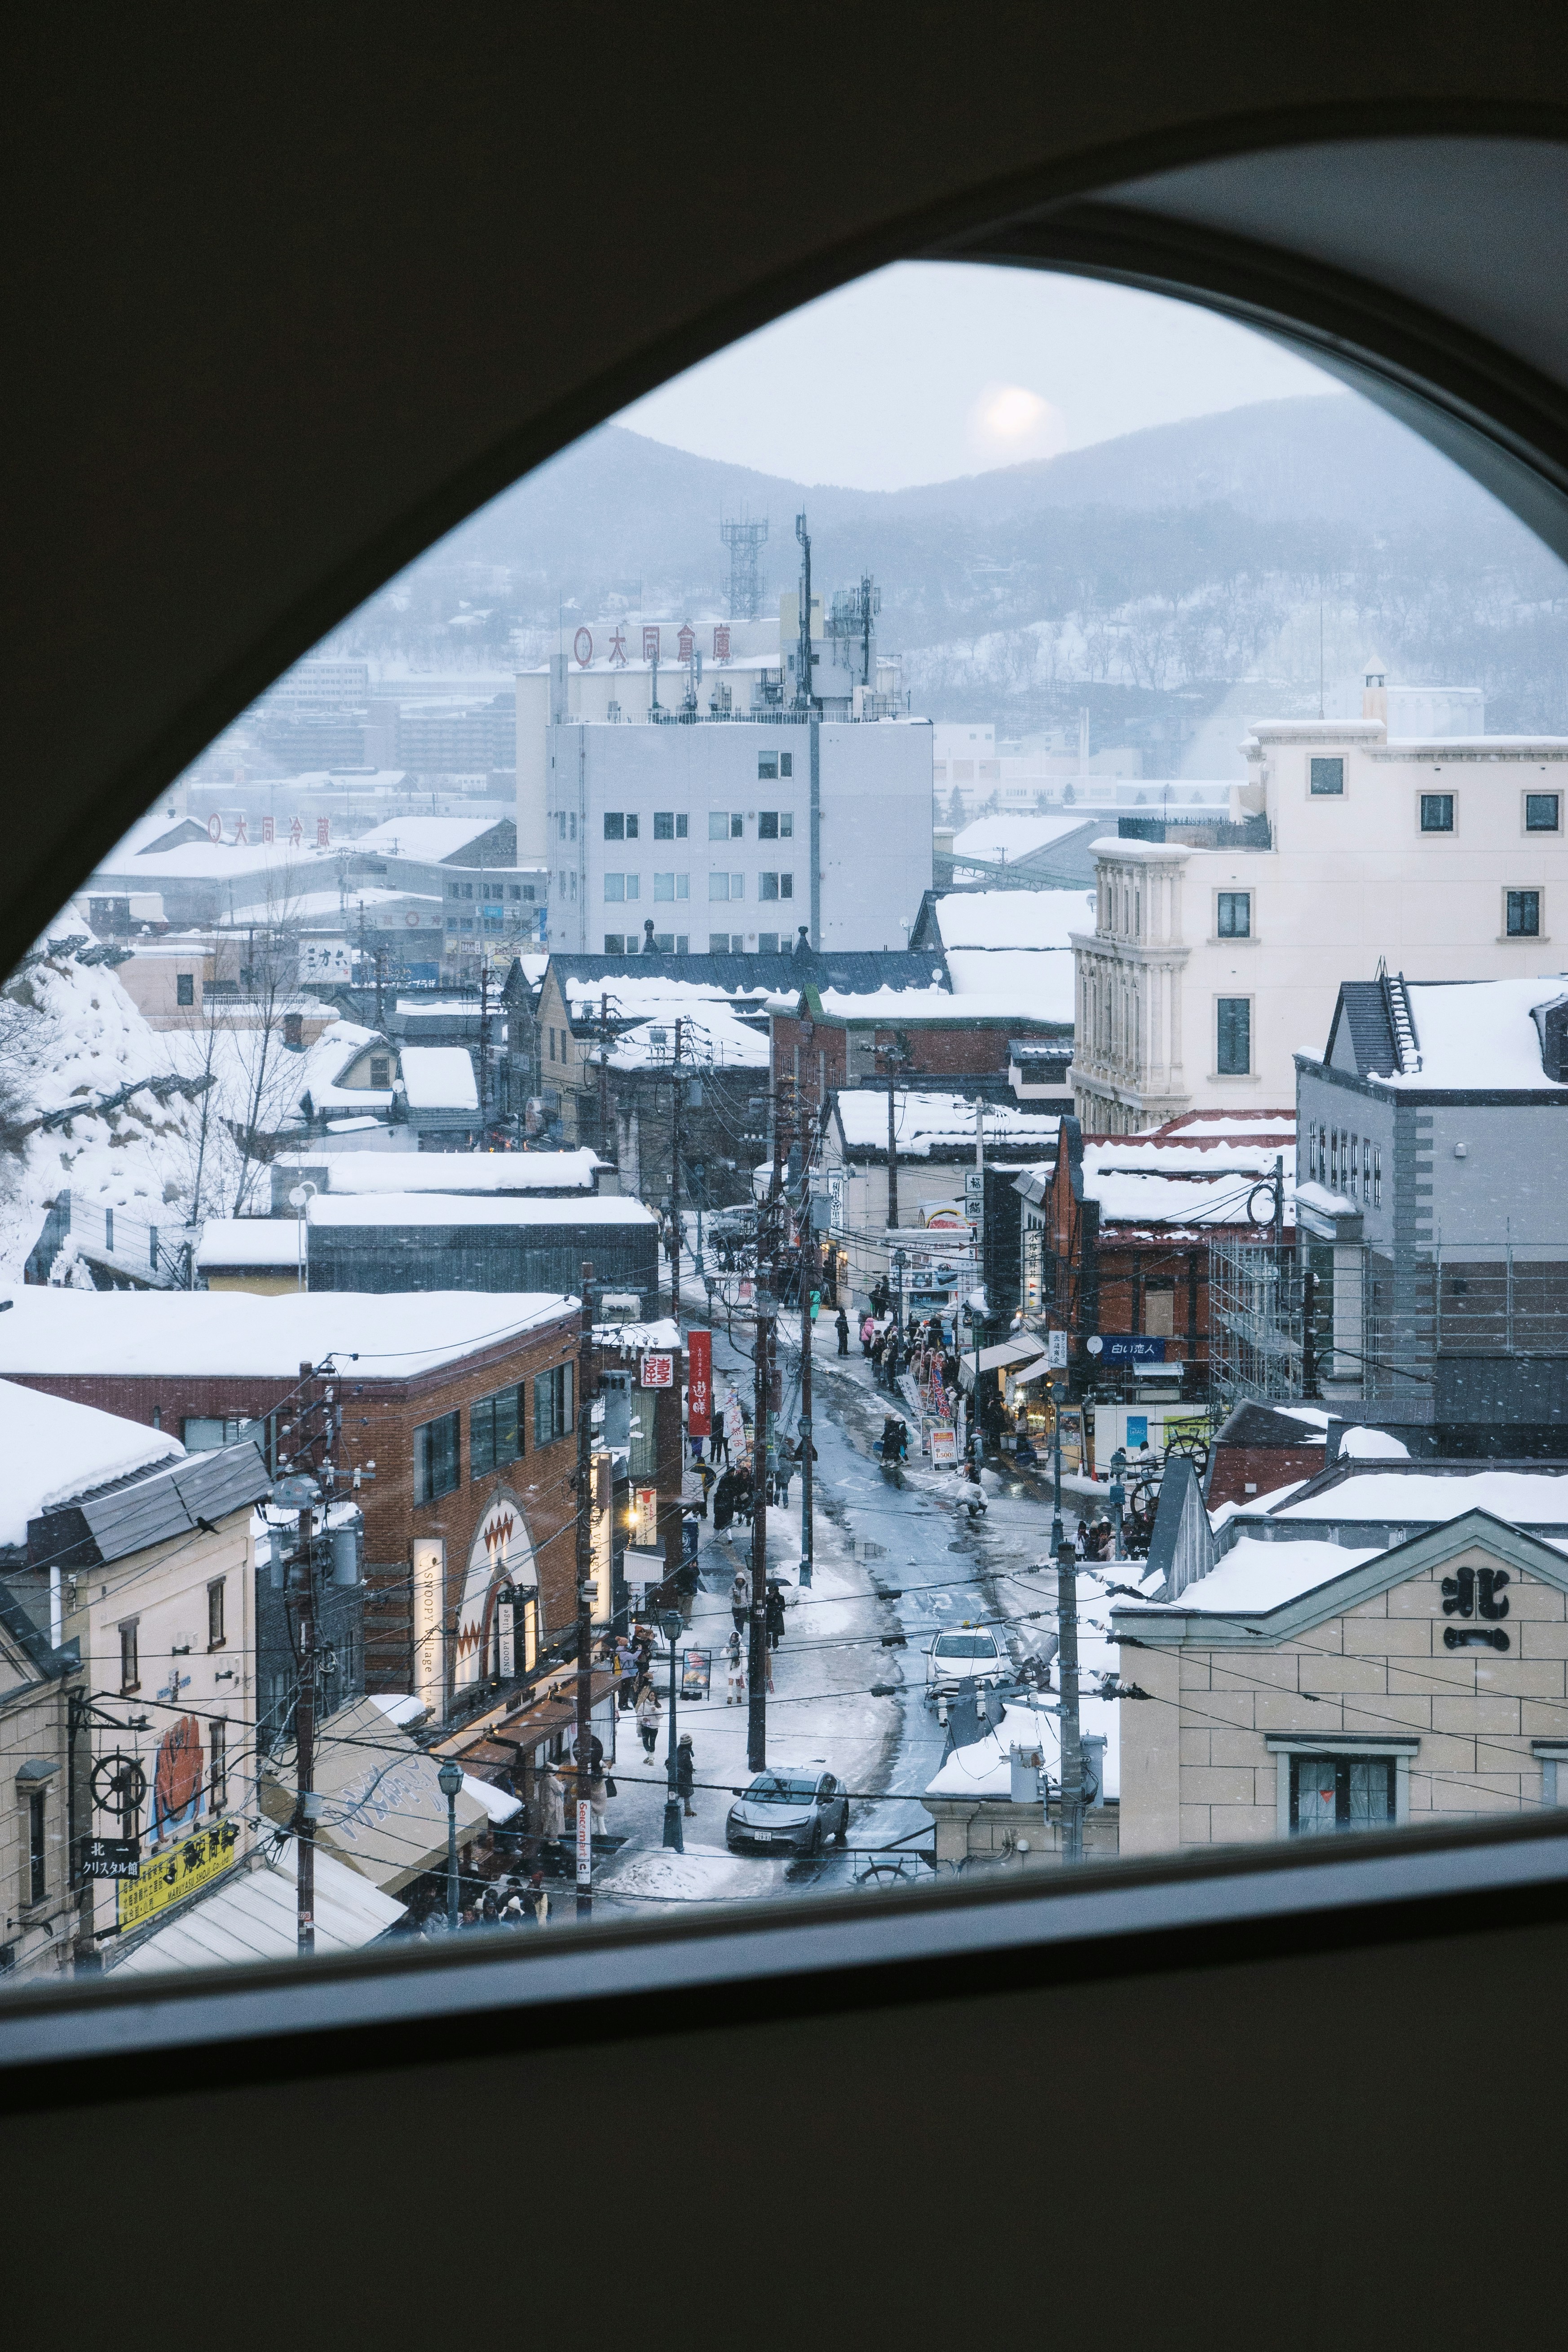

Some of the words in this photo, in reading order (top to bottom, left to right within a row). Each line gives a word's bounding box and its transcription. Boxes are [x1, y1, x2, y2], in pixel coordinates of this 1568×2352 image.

[1112, 1344, 1154, 1354] 白い恋人
[424, 1573, 433, 1622] SNOOPY
[422, 1629, 434, 1672] Village
[91, 1842, 129, 1856] 北一
[83, 1862, 137, 1876] クリスタル館
